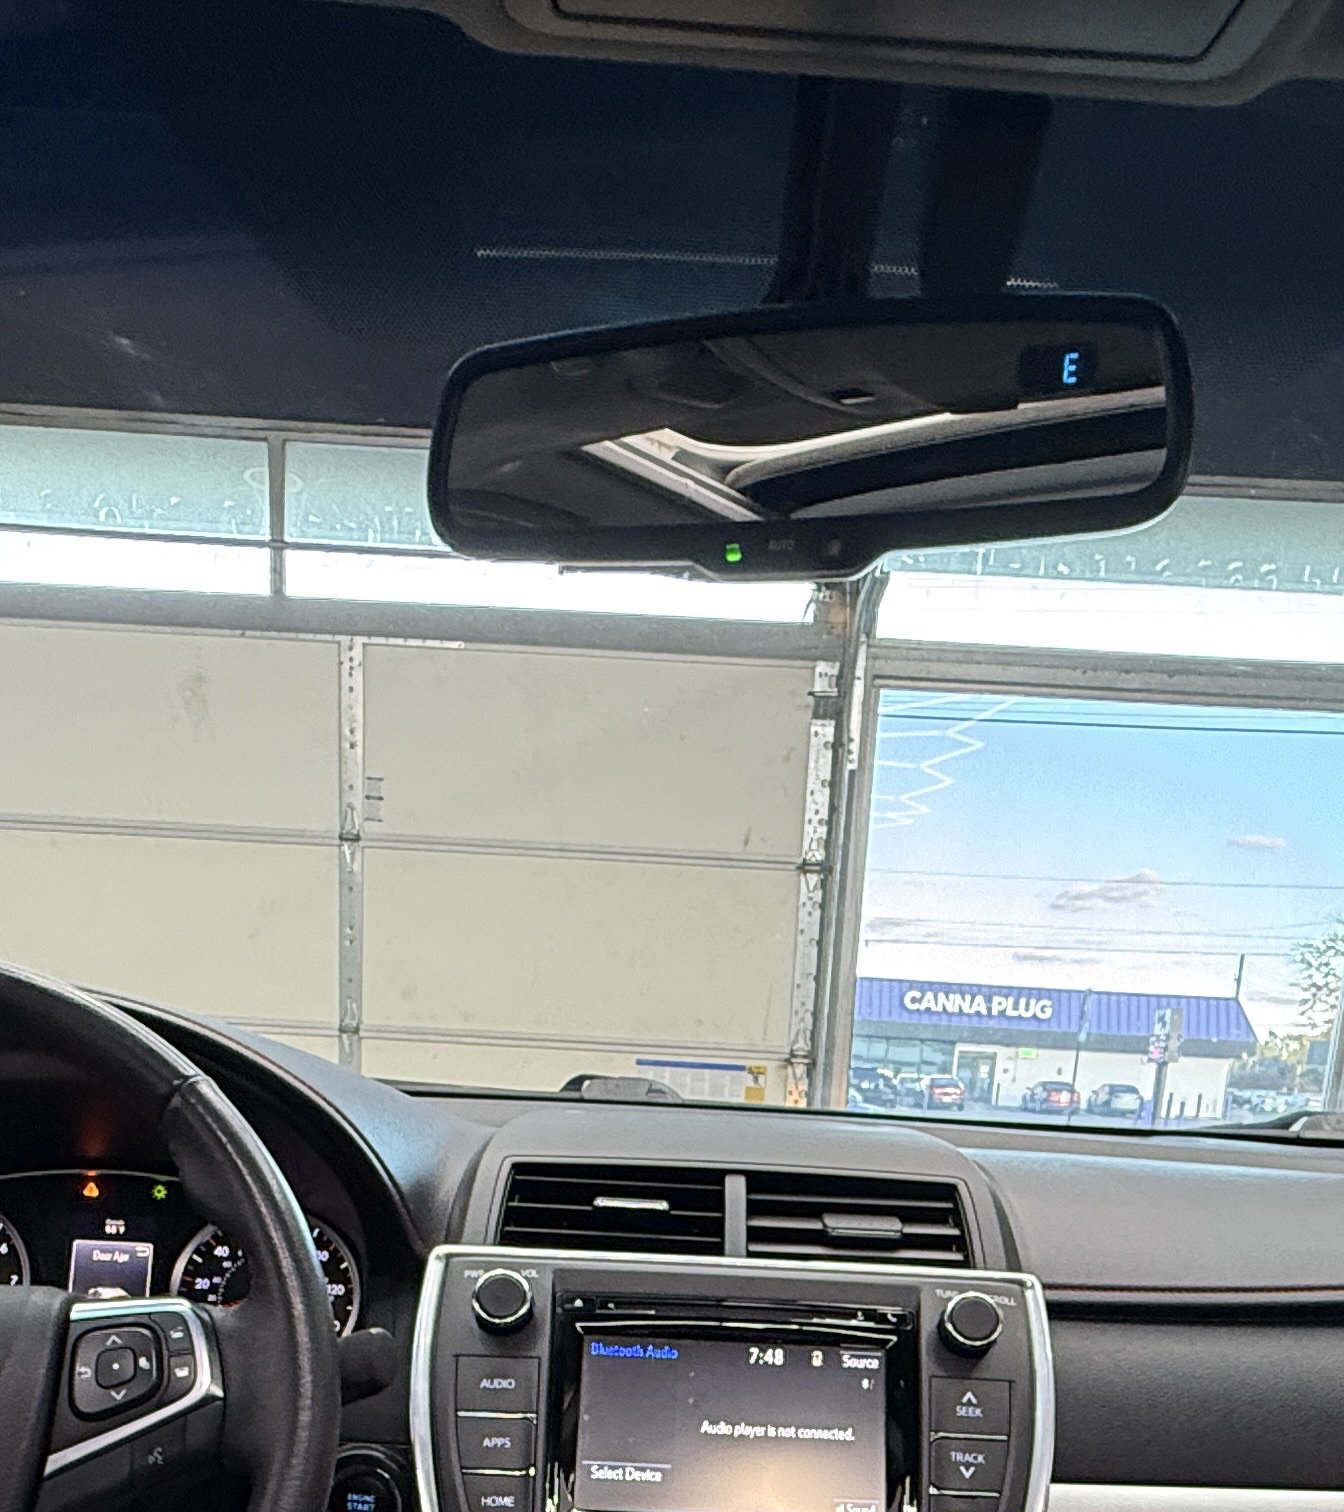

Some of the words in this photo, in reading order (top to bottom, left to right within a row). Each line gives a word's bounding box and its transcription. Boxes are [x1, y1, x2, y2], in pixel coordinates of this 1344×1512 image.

[1062, 352, 1079, 384] E
[903, 990, 988, 1016] CANNA
[991, 995, 1054, 1020] PLUG
[0, 1242, 9, 1255] 6
[213, 1245, 231, 1258] 40
[9, 1274, 19, 1287] 7
[194, 1277, 211, 1290] 20
[590, 1340, 644, 1360] Bluetooth
[645, 1343, 679, 1361] Audio
[748, 1347, 785, 1367] 7:48
[841, 1354, 880, 1371] Source
[479, 1377, 517, 1390] AUDIO
[955, 1404, 984, 1418] SEEK
[700, 1419, 733, 1437] Audio
[734, 1422, 766, 1440] player
[767, 1424, 777, 1438] is
[777, 1425, 797, 1439] not
[797, 1426, 856, 1442] connected.
[482, 1437, 512, 1449] APPS
[949, 1450, 986, 1465] TRACK
[590, 1464, 624, 1481] Select
[624, 1466, 663, 1483] Device
[346, 1501, 376, 1512] START
[481, 1495, 516, 1508] HOME
